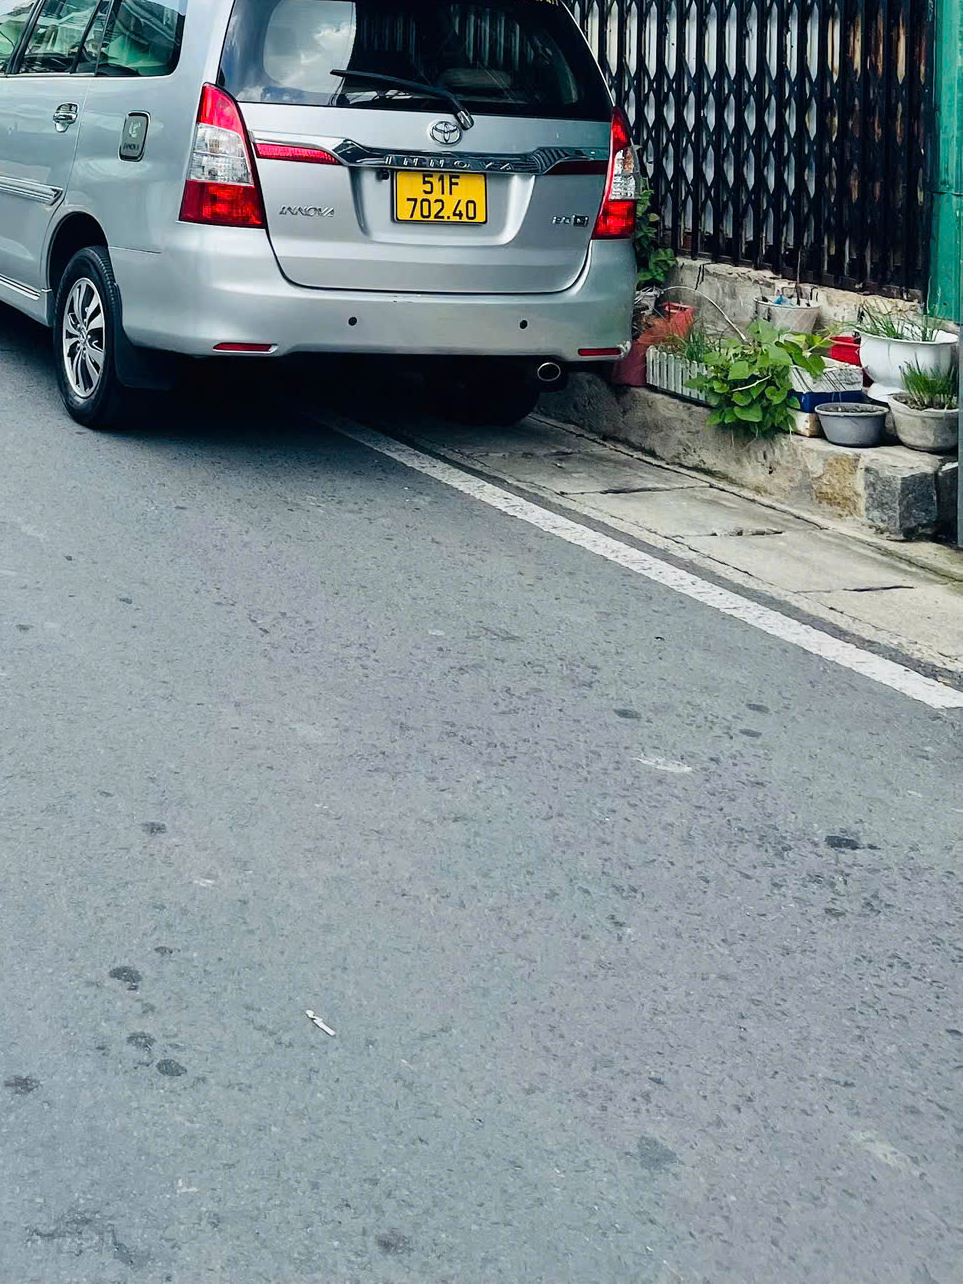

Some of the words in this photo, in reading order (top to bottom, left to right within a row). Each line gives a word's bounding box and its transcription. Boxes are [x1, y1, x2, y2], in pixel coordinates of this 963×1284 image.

[422, 173, 461, 196] 51F
[279, 205, 335, 218] INNOVA
[406, 197, 477, 221] 702.40
